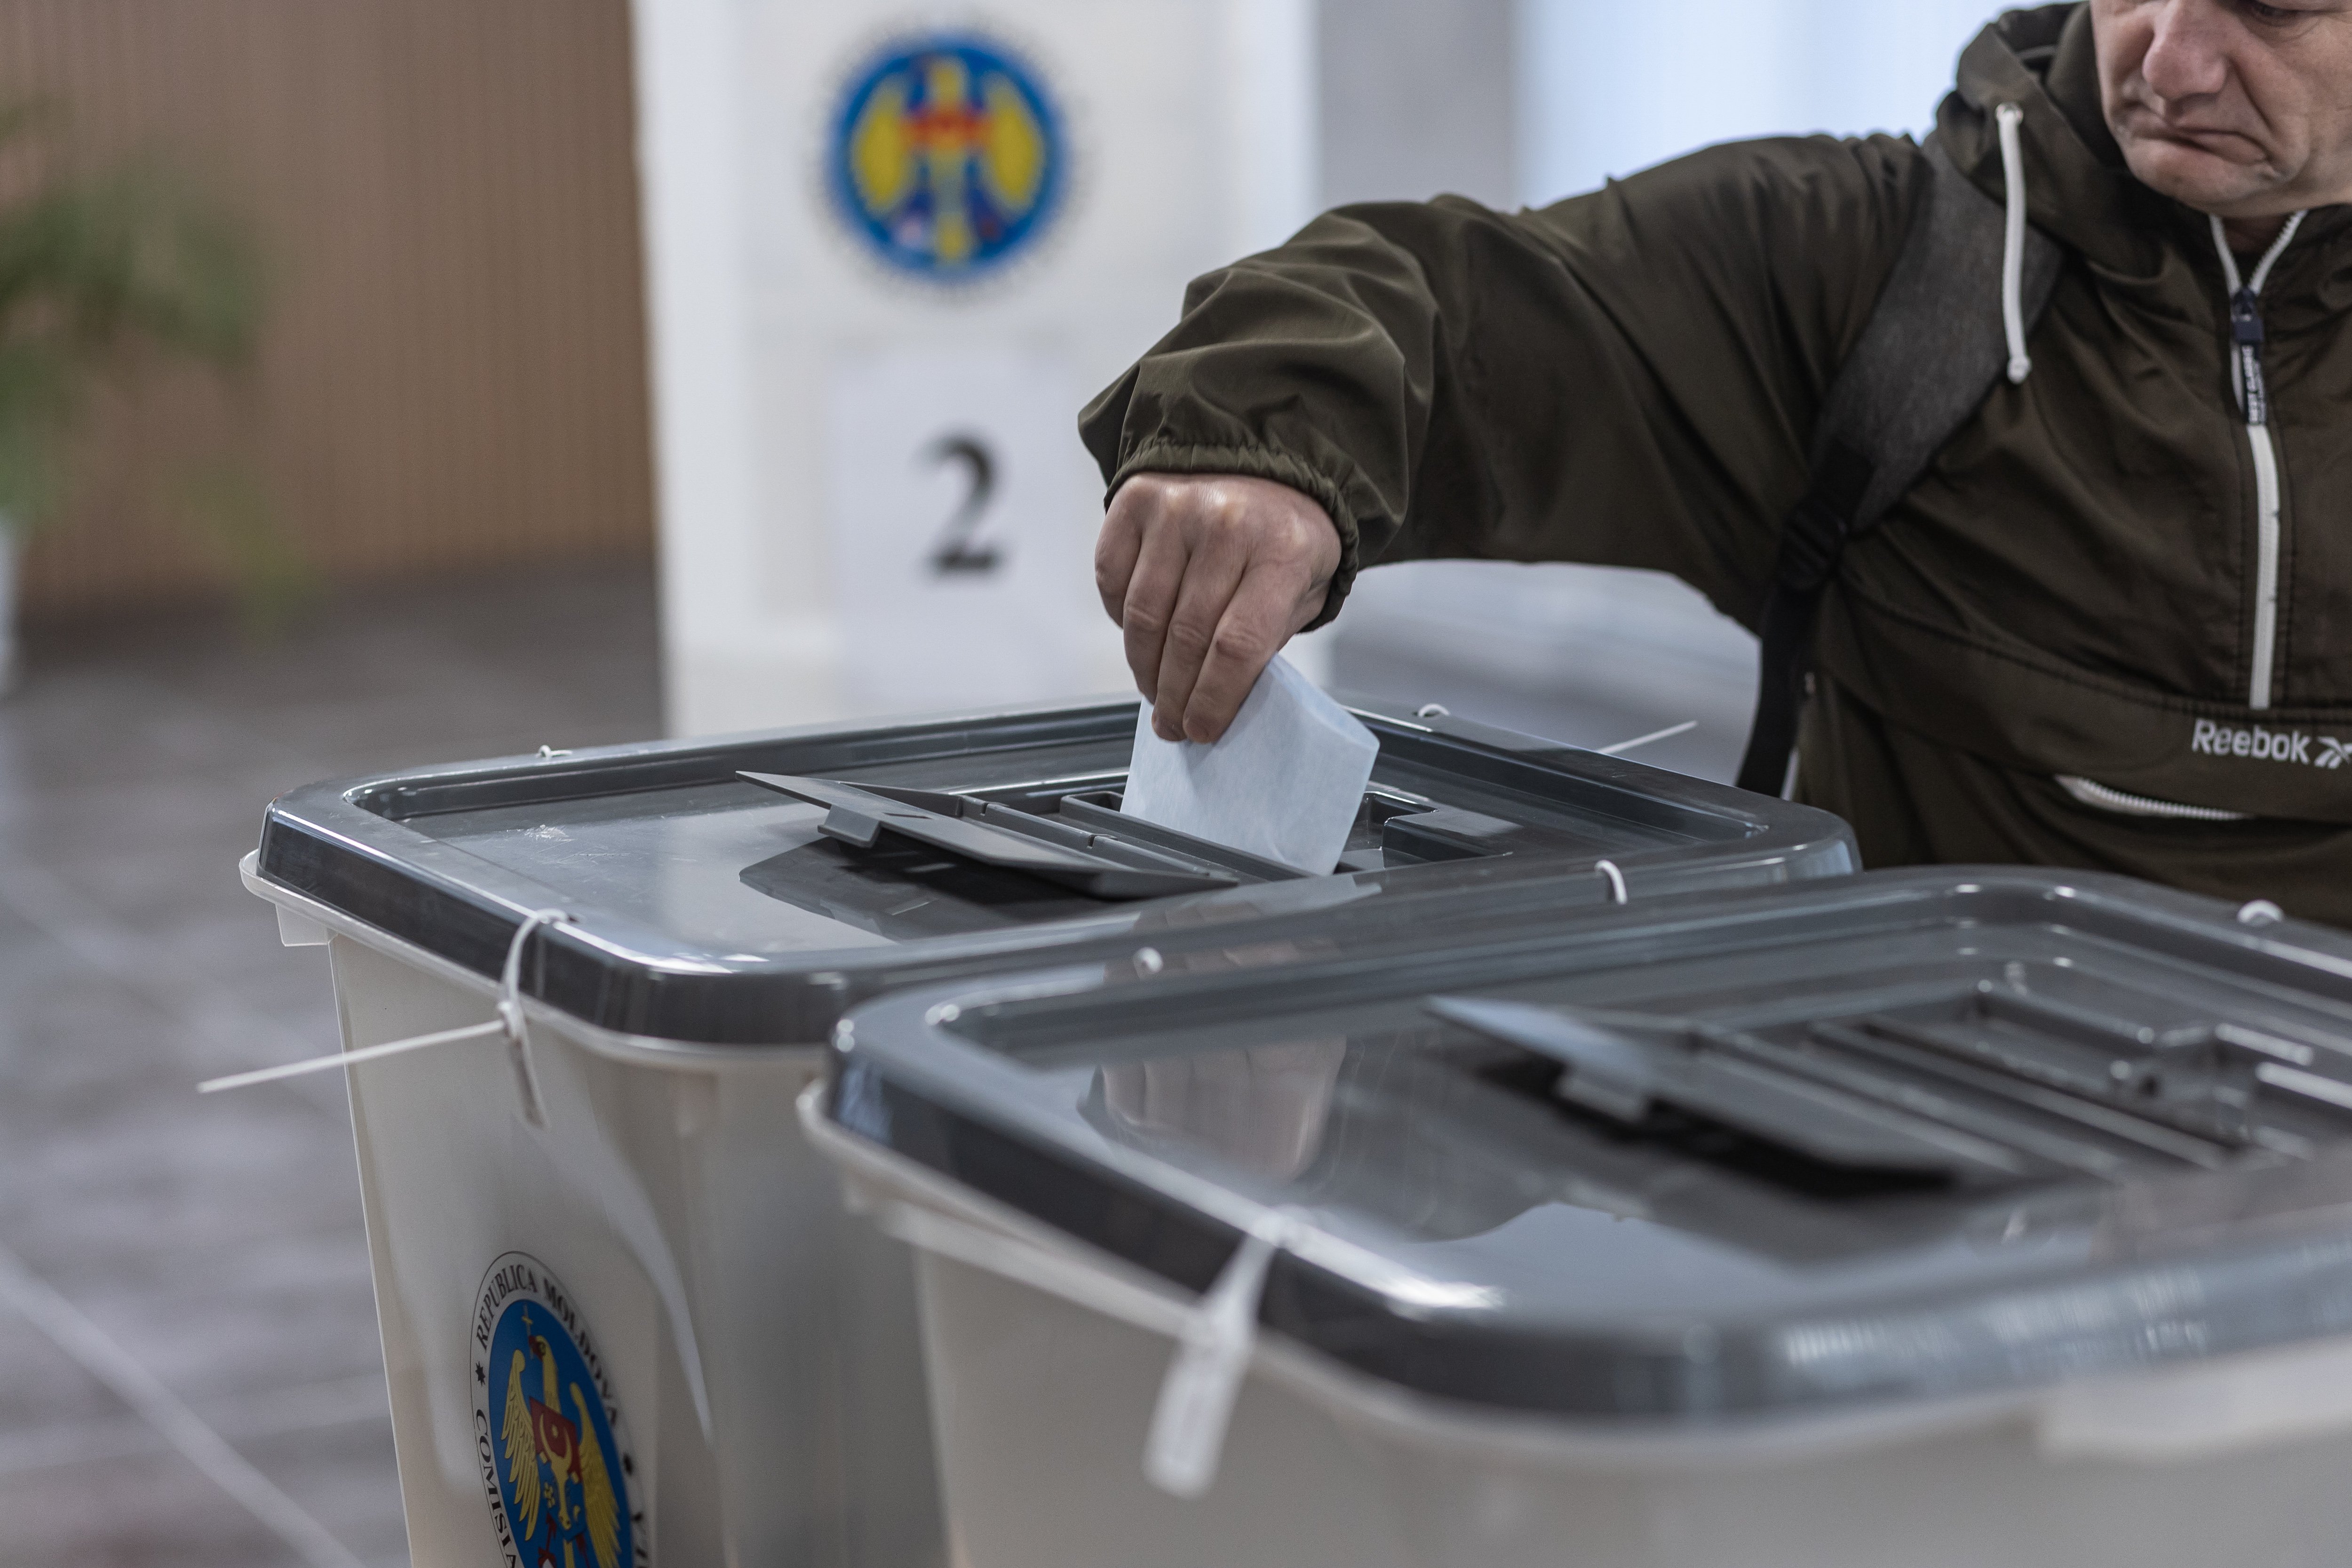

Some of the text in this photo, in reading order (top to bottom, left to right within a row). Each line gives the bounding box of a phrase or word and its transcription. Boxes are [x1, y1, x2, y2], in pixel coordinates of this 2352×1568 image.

[918, 427, 1004, 577] 2
[2192, 718, 2311, 765] Reebok
[476, 1264, 617, 1426] REPUBLICA MOLDOVA
